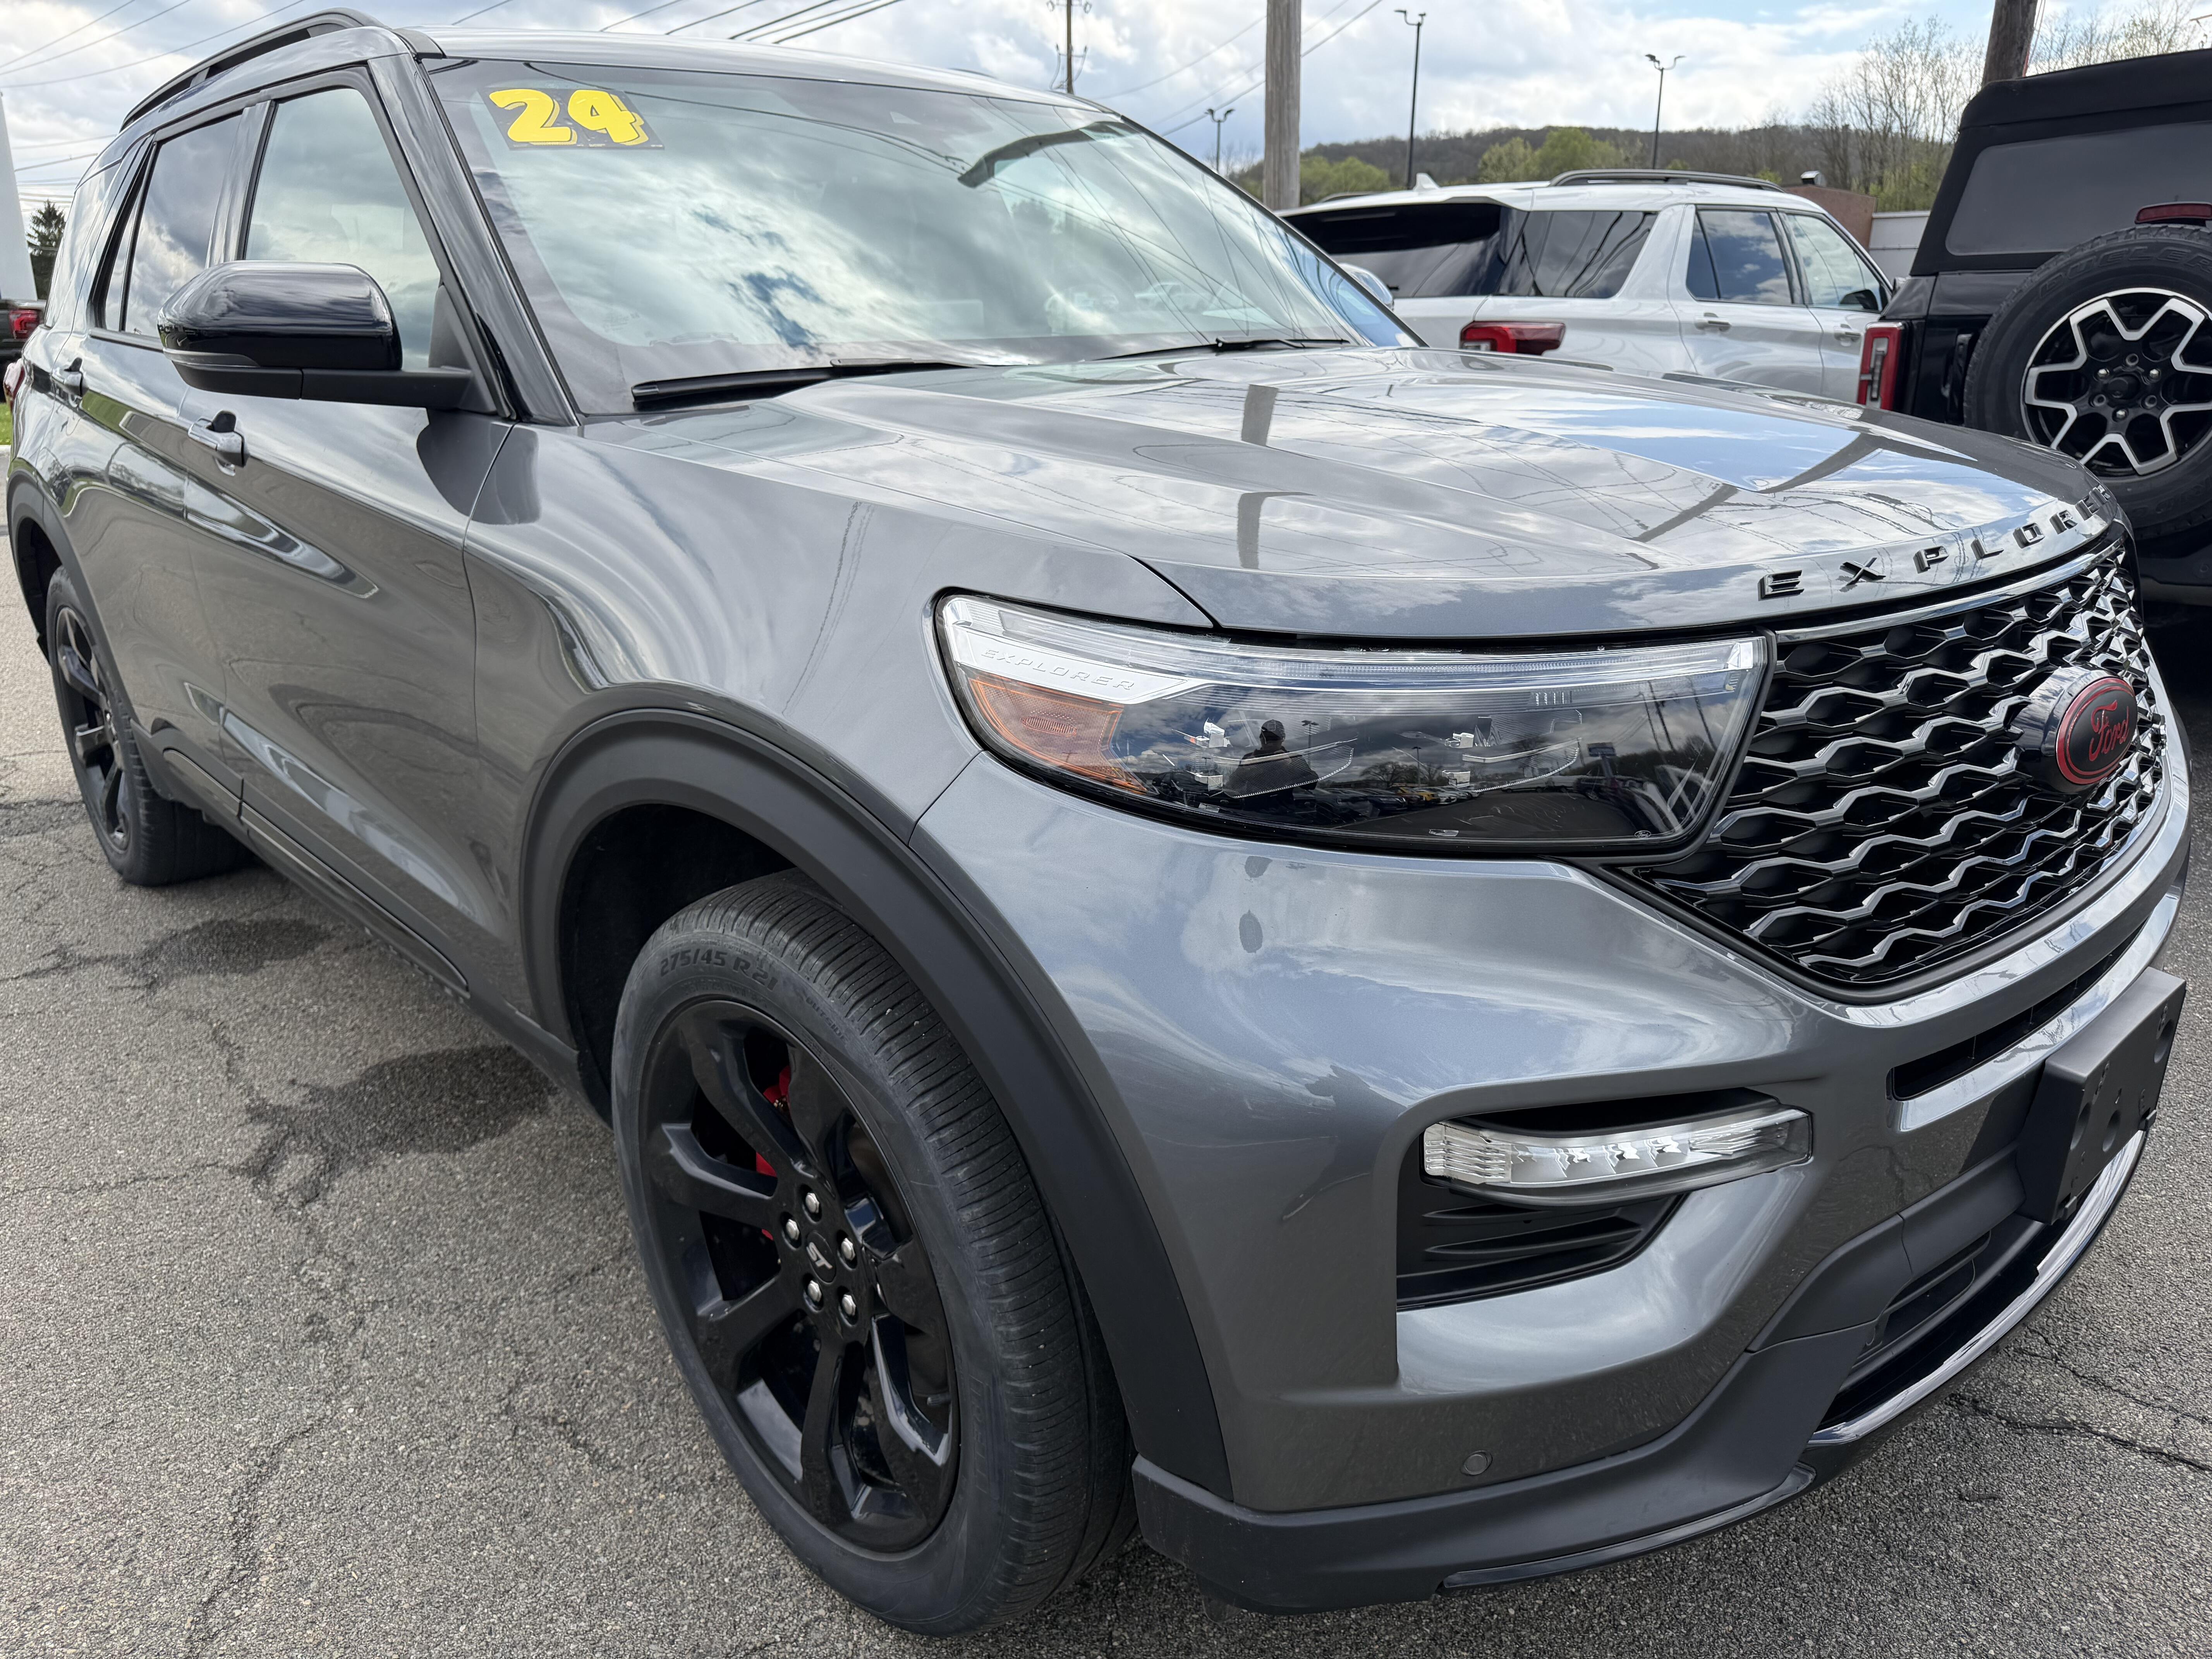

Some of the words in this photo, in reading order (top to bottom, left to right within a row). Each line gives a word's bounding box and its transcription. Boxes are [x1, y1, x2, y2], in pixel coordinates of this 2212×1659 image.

[489, 89, 649, 145] 24
[2039, 246, 2212, 299] DUELER
[1758, 484, 2111, 599] EXPLORER
[981, 649, 1135, 690] EXPLORER
[2089, 700, 2129, 762] Ford
[660, 948, 728, 977] 275/45
[806, 1242, 833, 1270] ST
